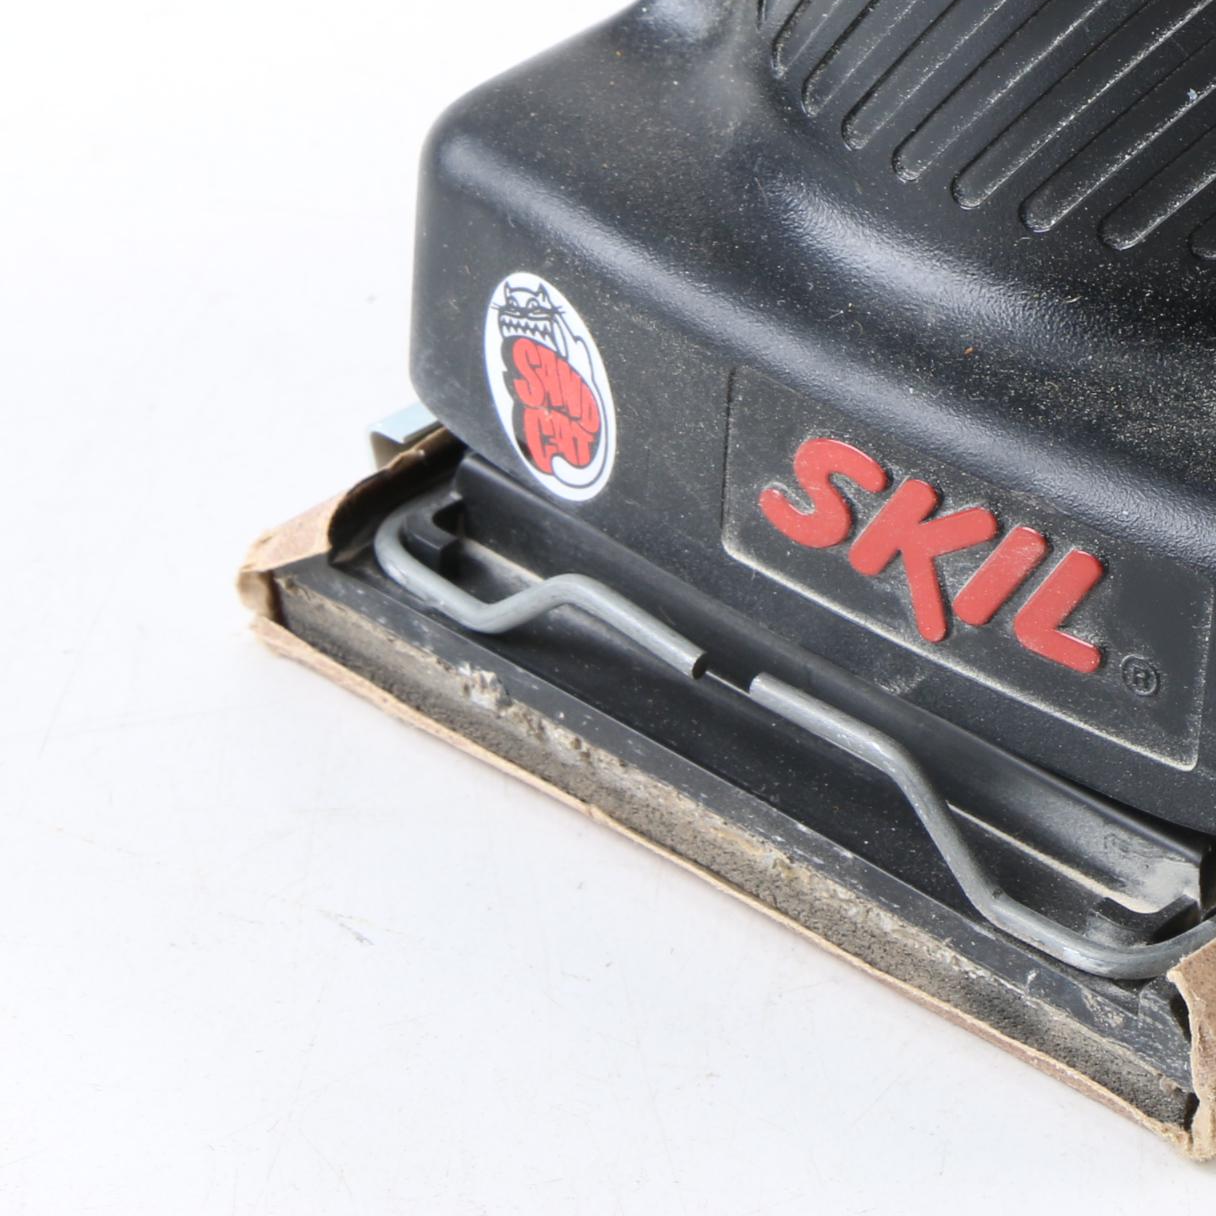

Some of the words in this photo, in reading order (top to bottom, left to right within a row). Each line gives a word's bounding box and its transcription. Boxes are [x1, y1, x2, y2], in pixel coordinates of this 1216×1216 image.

[513, 338, 600, 434] SAND
[524, 407, 596, 474] CAT
[759, 438, 1103, 673] SKIL
